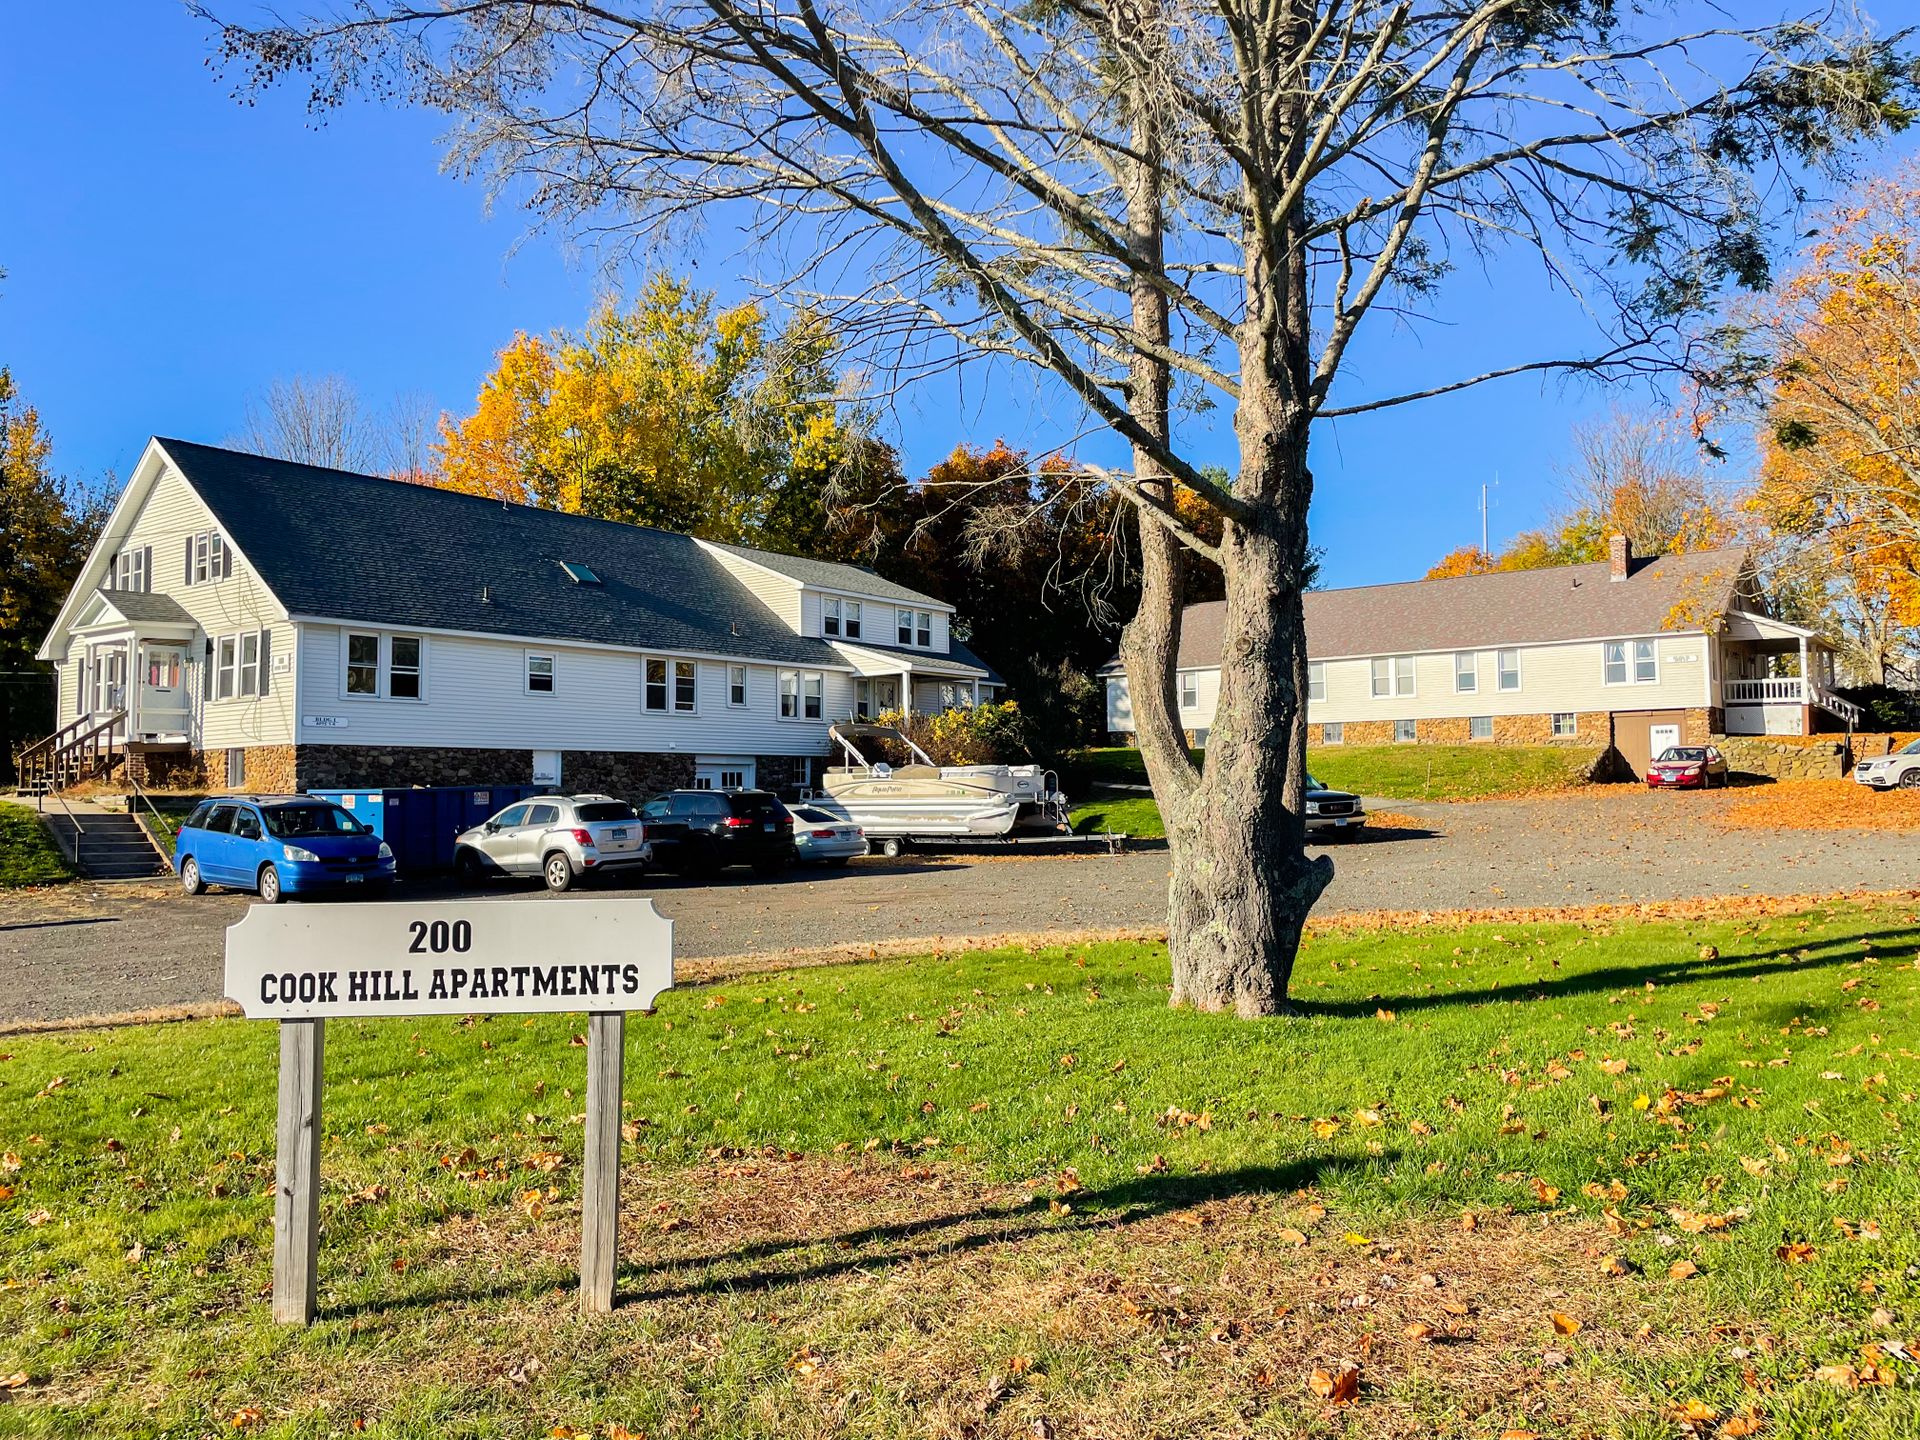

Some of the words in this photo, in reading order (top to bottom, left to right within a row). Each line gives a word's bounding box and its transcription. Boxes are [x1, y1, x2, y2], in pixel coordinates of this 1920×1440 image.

[408, 920, 472, 954] 200
[260, 972, 338, 1005] COOK
[348, 968, 419, 1002] HILL
[428, 964, 639, 1000] APARTMENTS
